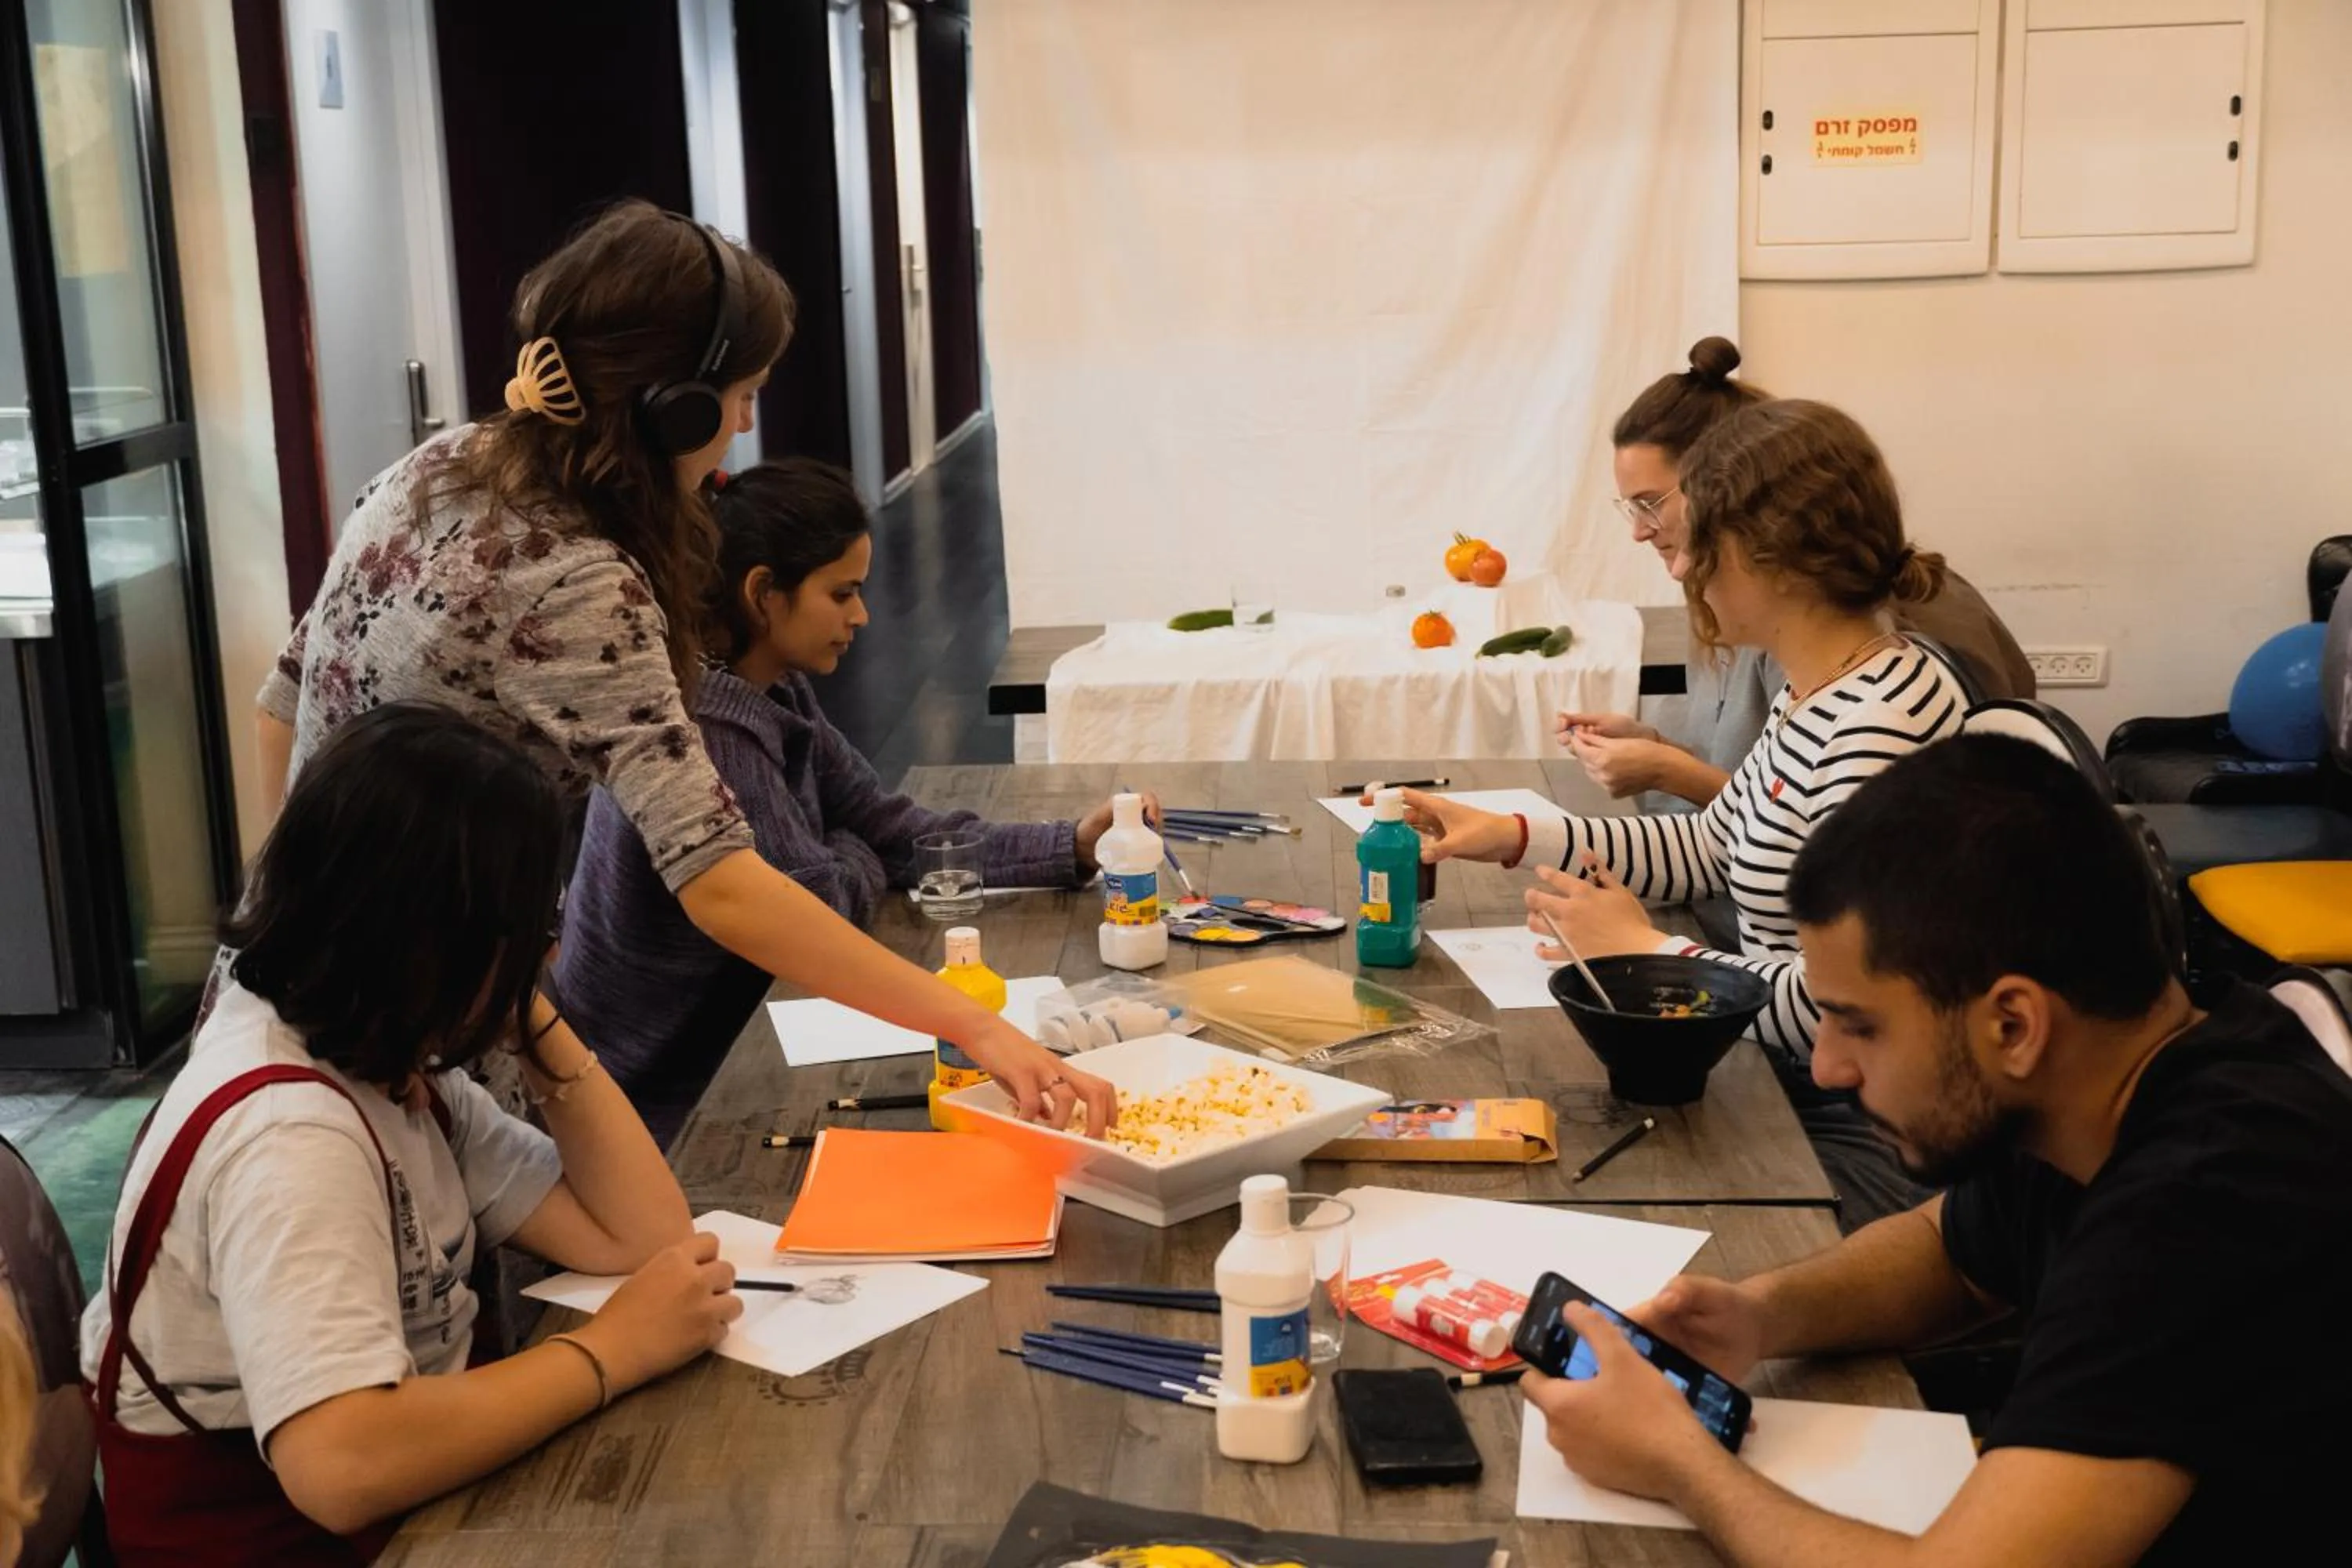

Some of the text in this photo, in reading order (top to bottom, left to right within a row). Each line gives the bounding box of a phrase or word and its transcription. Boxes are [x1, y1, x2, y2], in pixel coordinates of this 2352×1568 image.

[1816, 118, 1917, 138] מפסק זרם
[1867, 144, 1904, 155] חשמל
